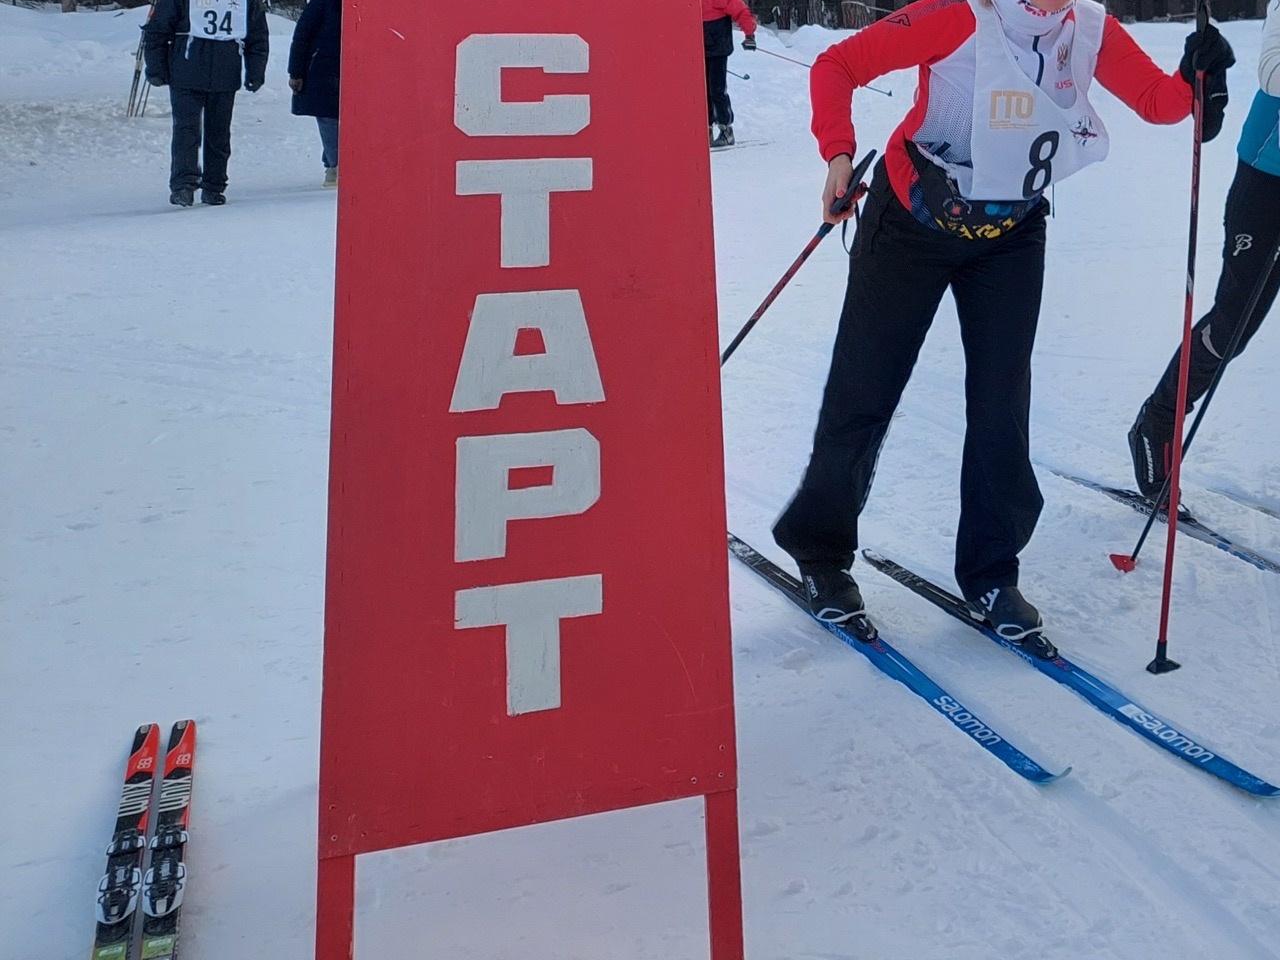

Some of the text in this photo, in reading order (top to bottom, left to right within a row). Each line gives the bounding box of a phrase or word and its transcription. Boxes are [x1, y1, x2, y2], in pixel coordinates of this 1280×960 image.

[203, 10, 233, 36] 34
[989, 90, 1034, 120] ГТО
[1022, 130, 1060, 200] 8
[447, 33, 606, 716] СТАРТ
